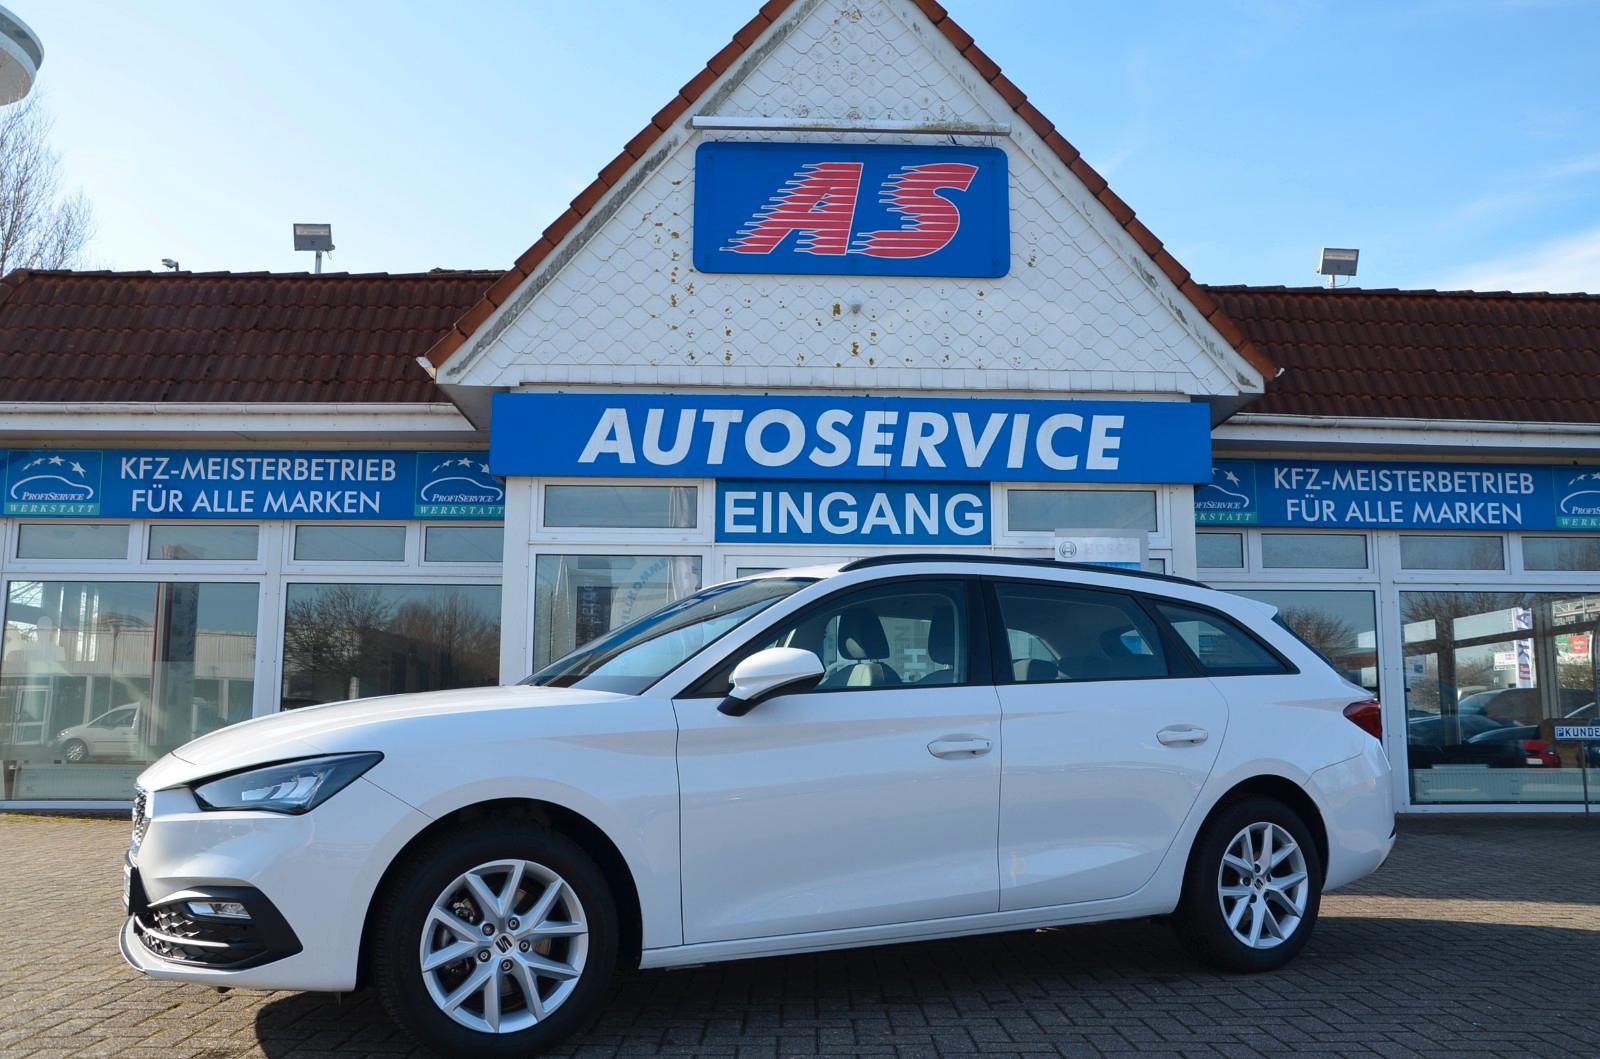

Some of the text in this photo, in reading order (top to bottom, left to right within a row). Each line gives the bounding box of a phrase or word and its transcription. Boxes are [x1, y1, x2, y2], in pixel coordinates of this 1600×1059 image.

[719, 162, 980, 259] AS
[577, 407, 1126, 472] AUTOSERVICE
[120, 456, 396, 482] KFZ-MEISTERBETRIEB
[1273, 467, 1535, 495] KFZ-MEISTERBETRIEB
[9, 503, 95, 513] WERKSTATT
[131, 484, 380, 514] FÜR ALLE MARKEN
[420, 507, 504, 515] WERKSTATT
[724, 491, 985, 536] EINGANG
[1286, 493, 1523, 525] FÜR ALLE MARKEN
